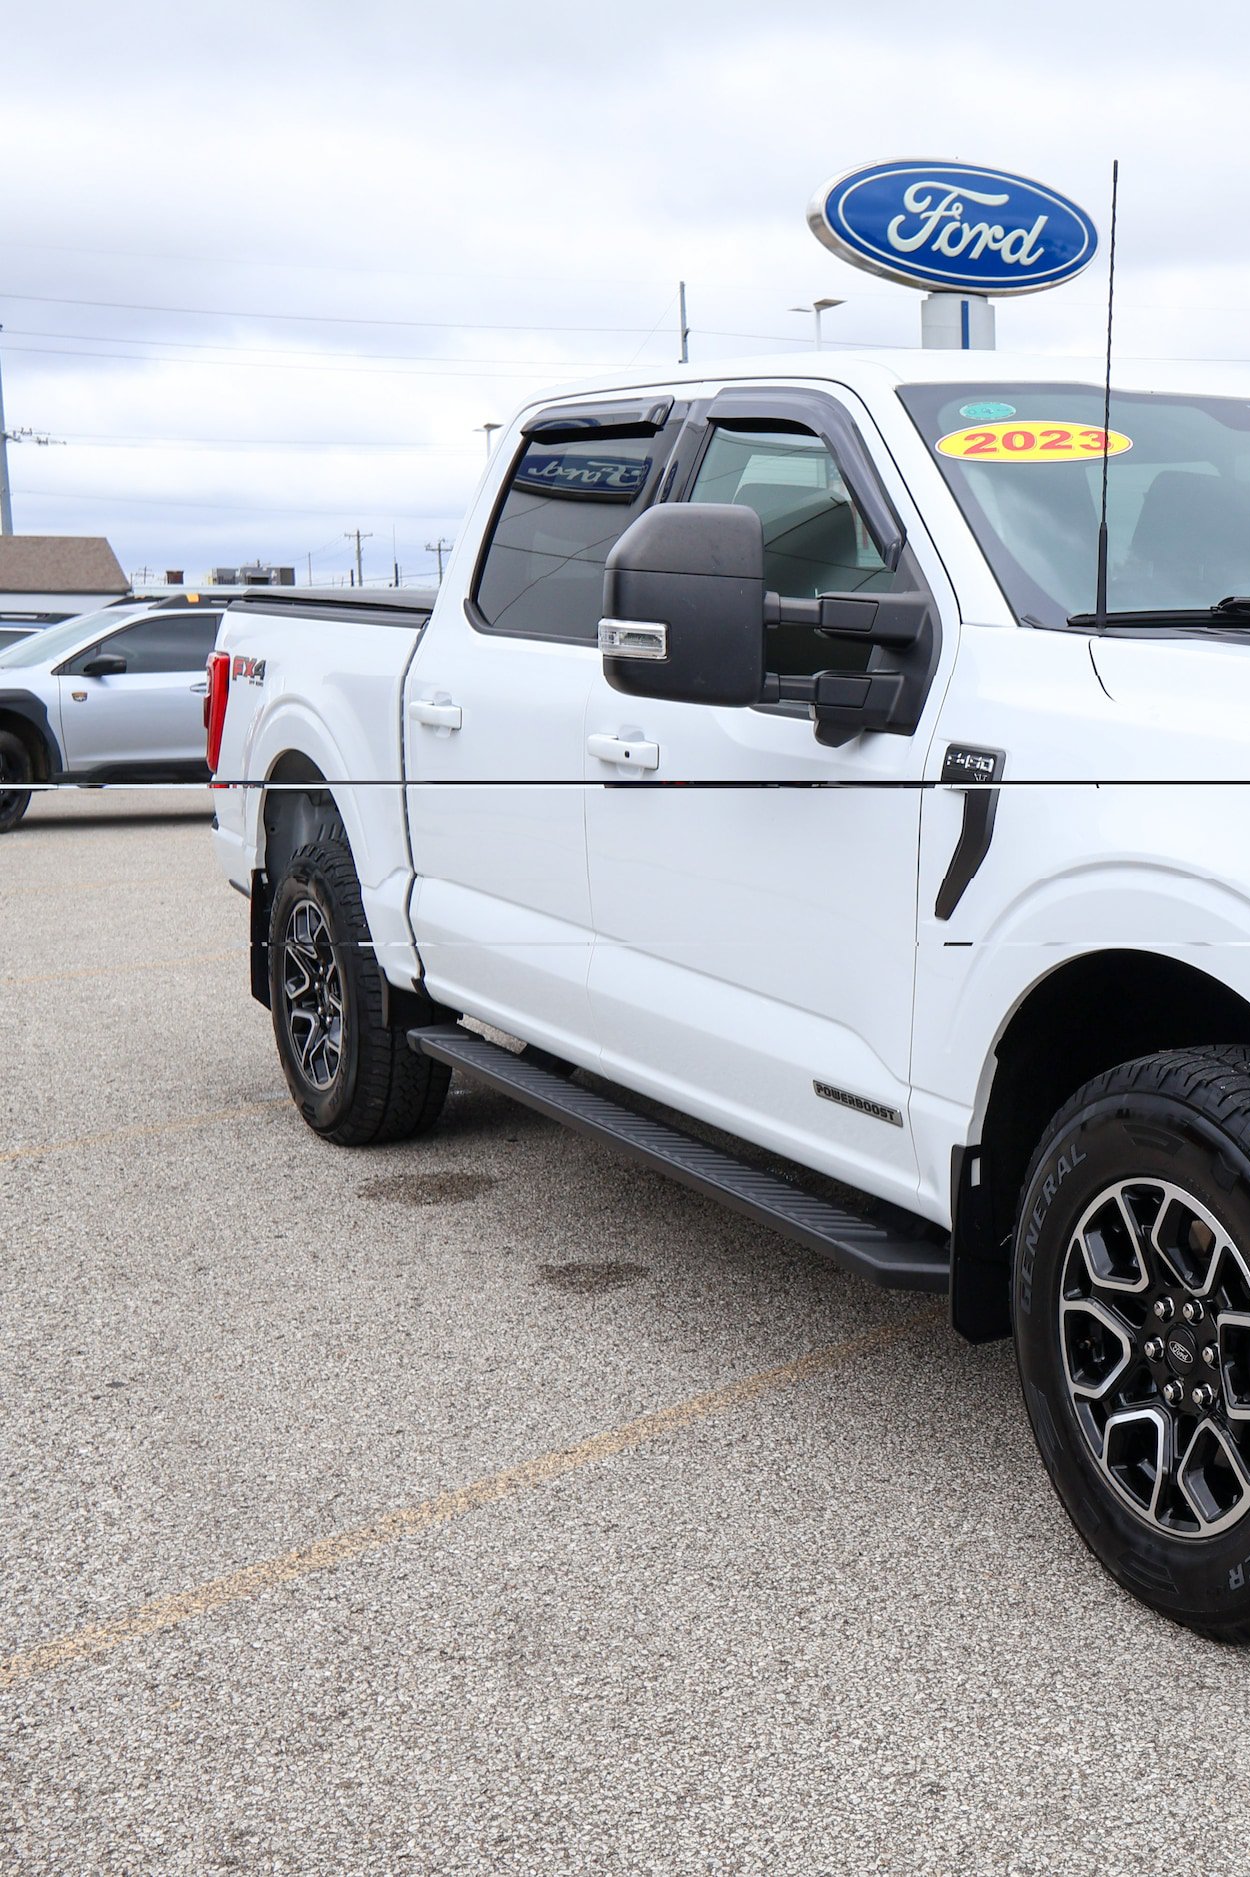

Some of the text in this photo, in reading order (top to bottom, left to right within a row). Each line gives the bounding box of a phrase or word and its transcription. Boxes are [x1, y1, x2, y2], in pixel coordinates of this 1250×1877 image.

[887, 181, 1048, 266] Ford
[962, 430, 1113, 455] 2023
[232, 655, 266, 681] FX4
[816, 1084, 895, 1120] POWERBOOST
[1020, 1144, 1087, 1315] GENERAL
[1172, 1343, 1189, 1360] Ford
